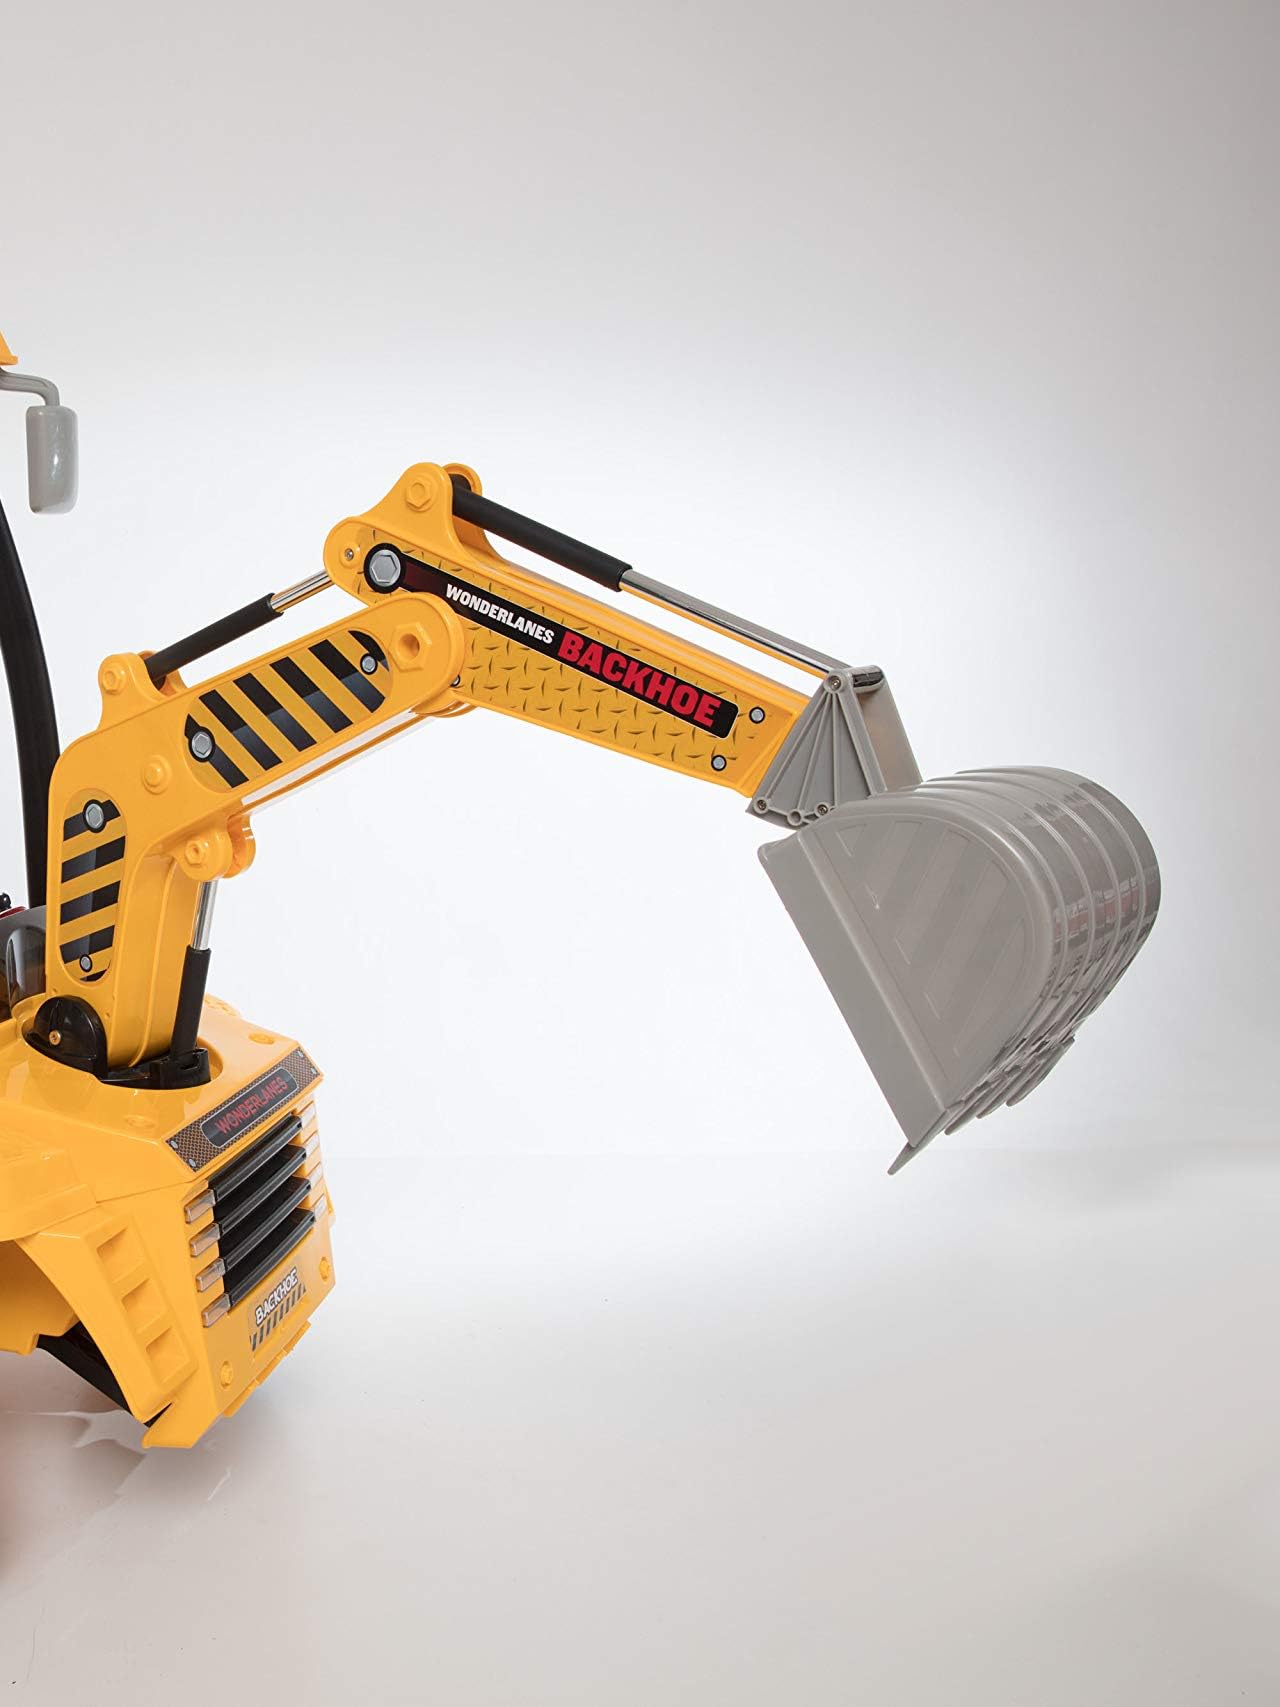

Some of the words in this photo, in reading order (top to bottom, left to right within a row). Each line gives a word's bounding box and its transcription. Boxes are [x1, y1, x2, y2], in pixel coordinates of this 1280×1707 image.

[445, 583, 556, 645] WONDERLANES
[557, 630, 722, 727] BACKHOE
[215, 1076, 288, 1134] WONDERLANES
[255, 1267, 298, 1326] BACKHOE
